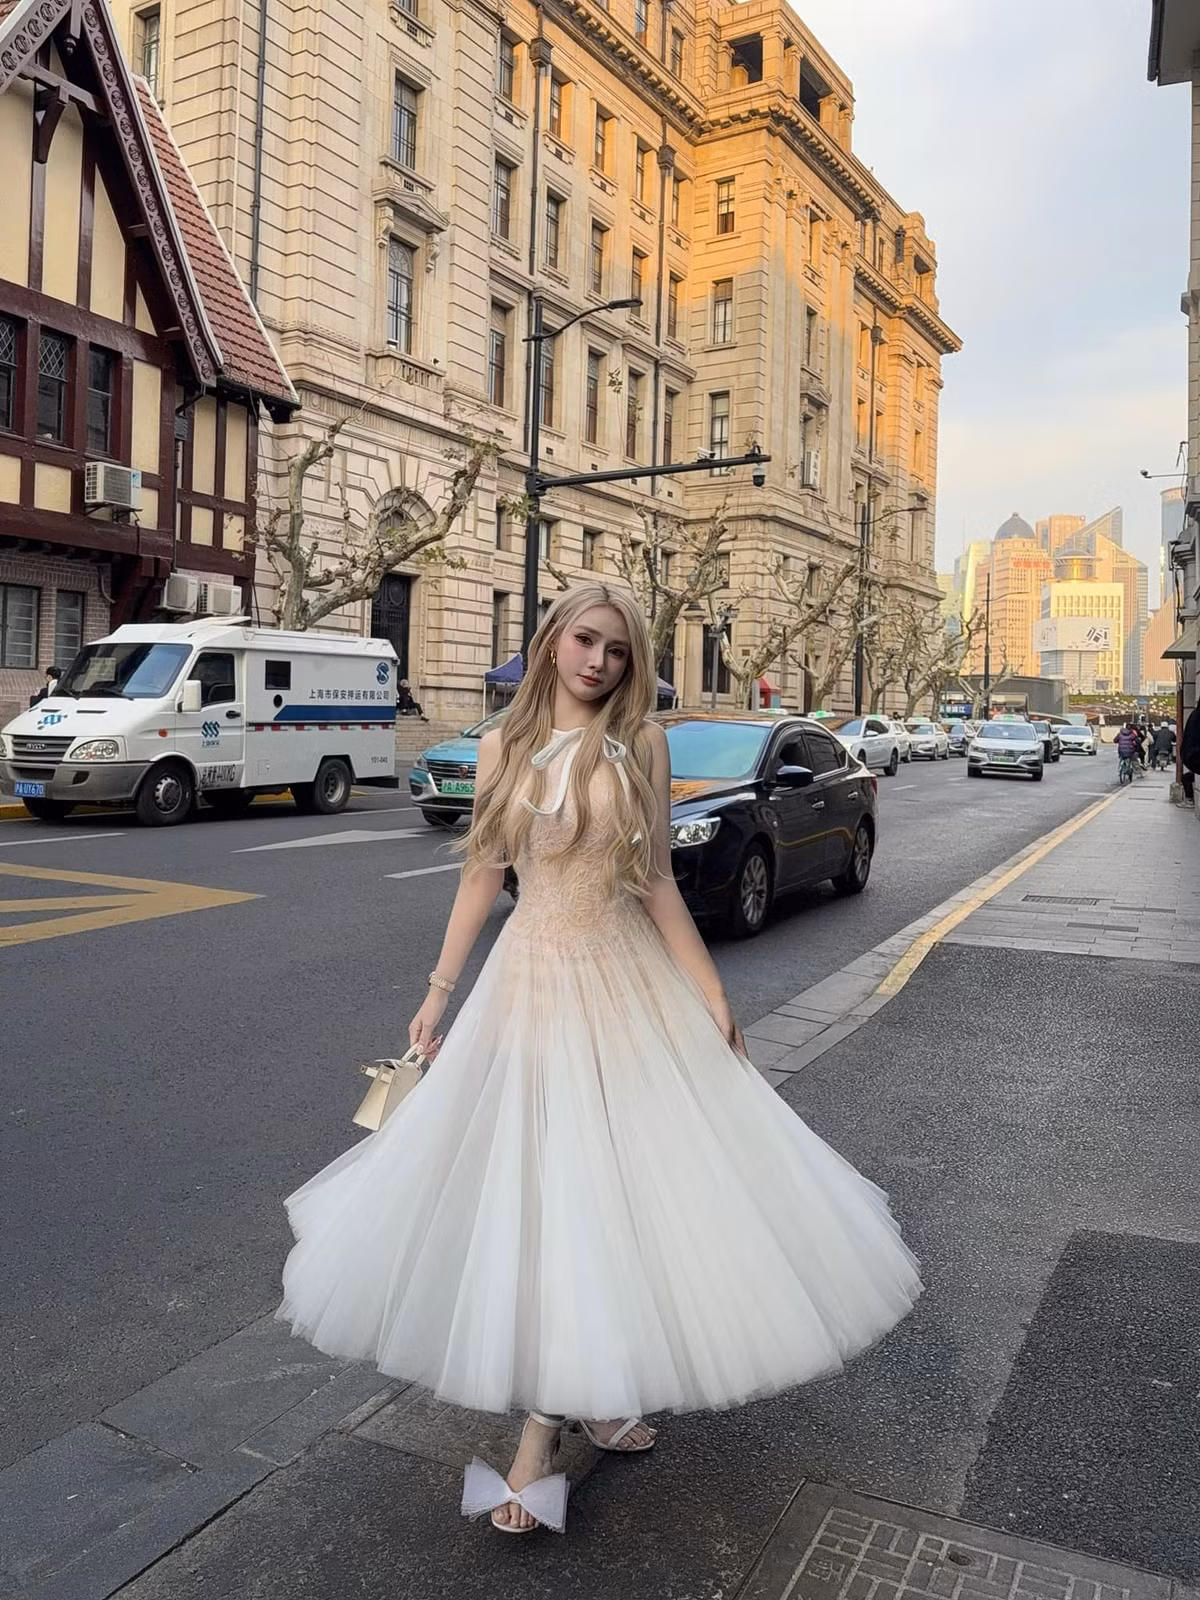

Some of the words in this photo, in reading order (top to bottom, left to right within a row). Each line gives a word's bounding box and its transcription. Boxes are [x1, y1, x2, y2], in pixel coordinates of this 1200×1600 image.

[309, 689, 390, 700] 上海市保安押运有限公司
